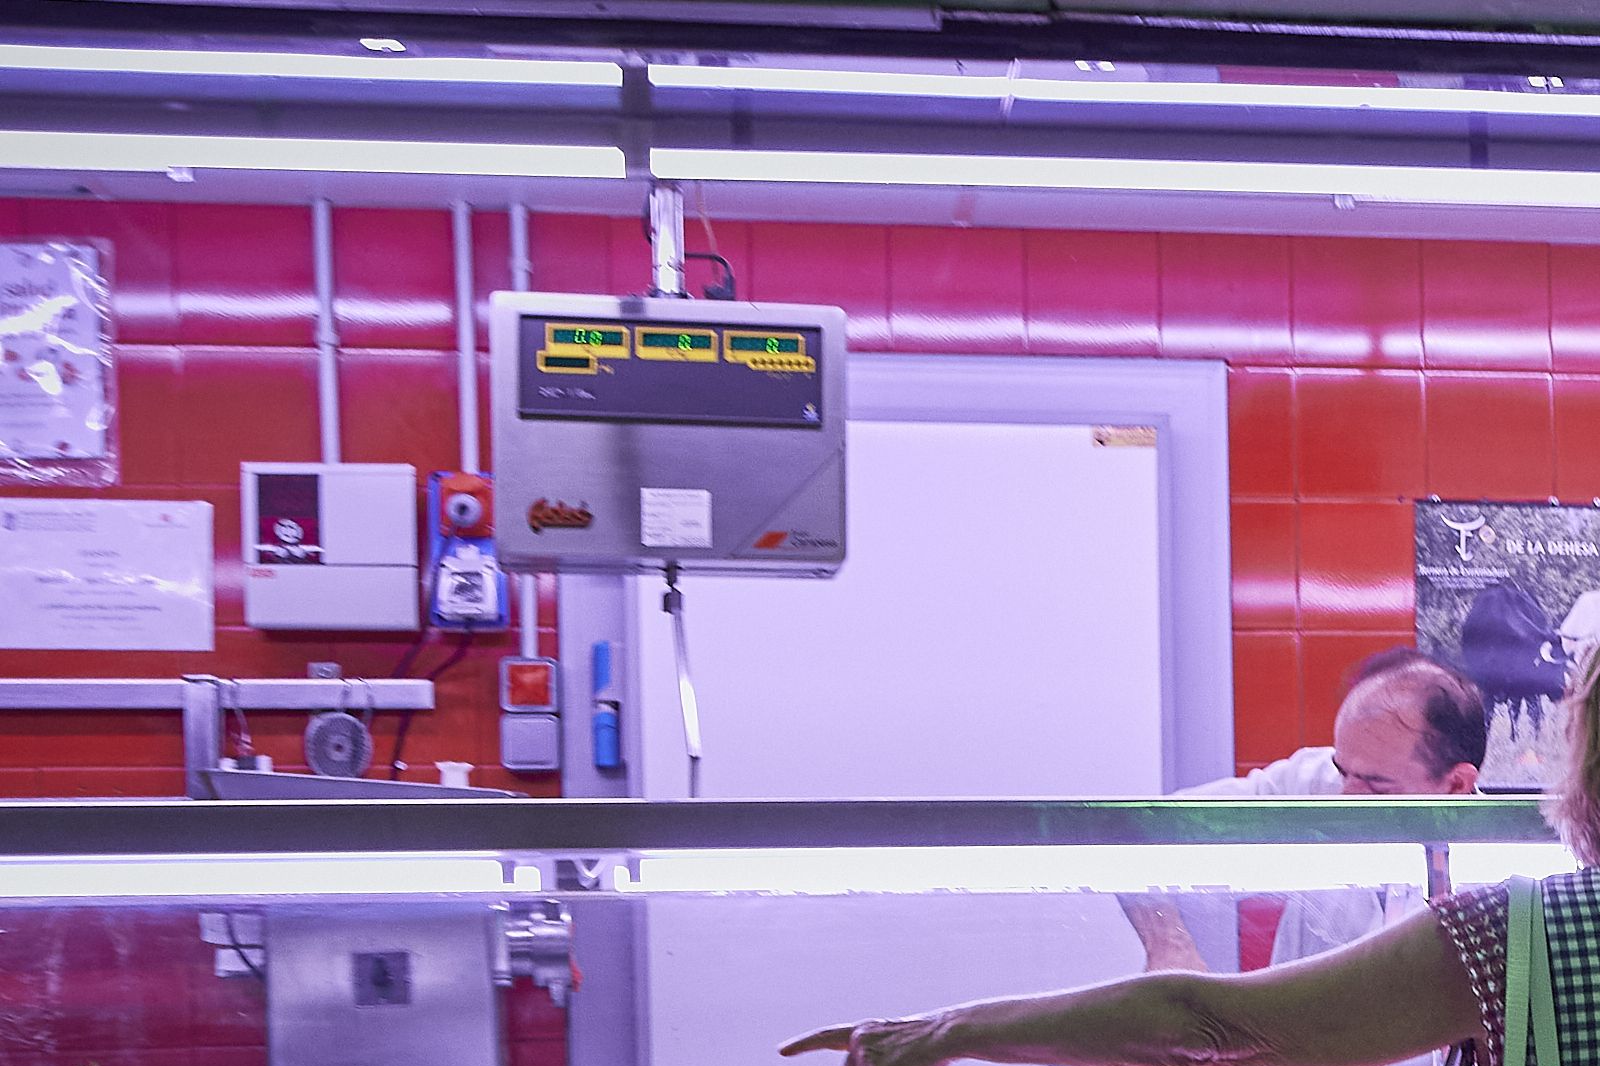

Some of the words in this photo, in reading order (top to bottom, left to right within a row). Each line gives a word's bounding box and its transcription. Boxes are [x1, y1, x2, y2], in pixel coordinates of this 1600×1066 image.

[1506, 540, 1525, 554] DE
[1526, 541, 1545, 555] LA
[1547, 541, 1599, 557] DEHESA
